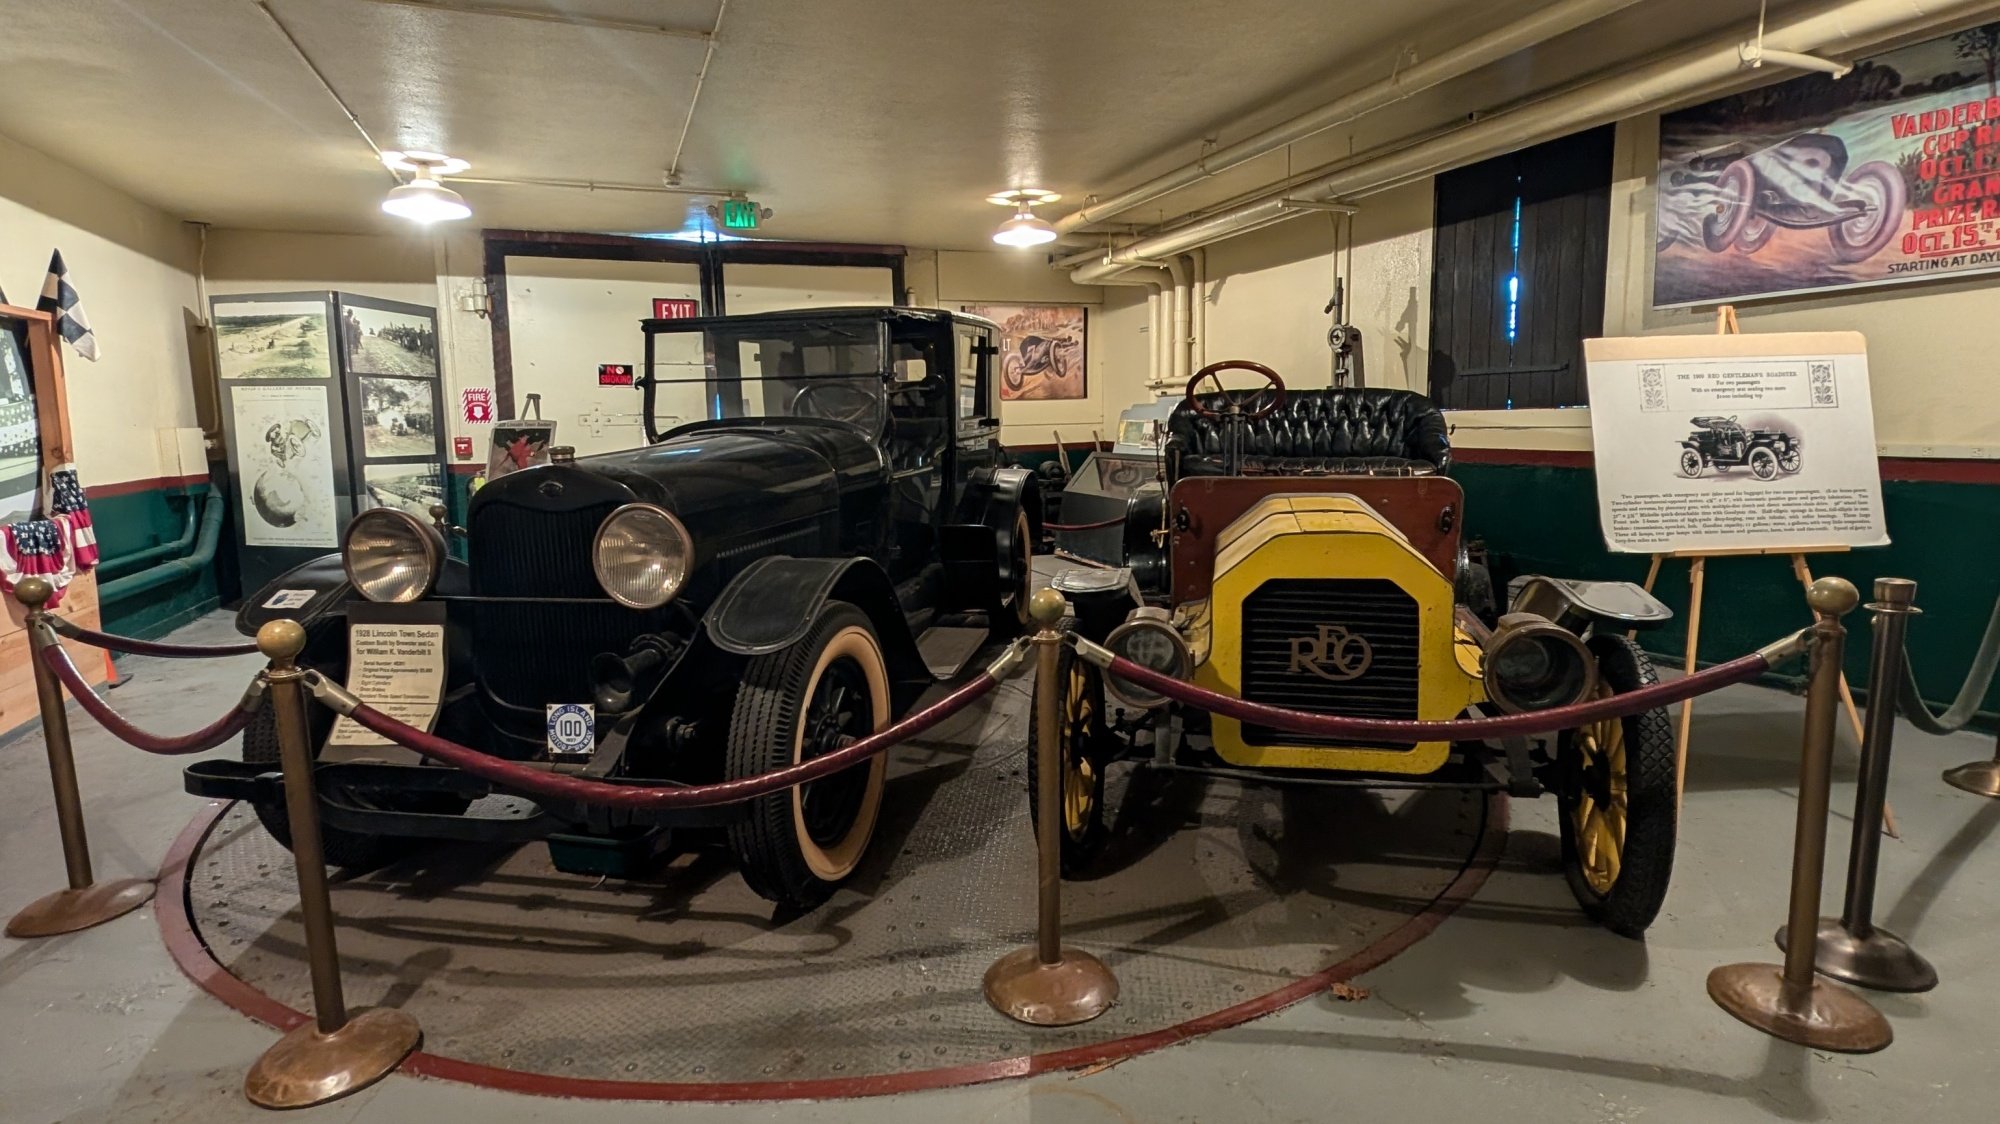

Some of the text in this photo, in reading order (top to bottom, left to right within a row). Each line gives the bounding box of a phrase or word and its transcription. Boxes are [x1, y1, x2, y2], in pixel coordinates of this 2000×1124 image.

[1923, 129, 1970, 157] CUP
[725, 202, 755, 227] EXIT
[1912, 202, 1977, 231] PRIZE
[1902, 231, 1950, 255] OCT.
[1888, 257, 1948, 274] STARTING
[1951, 255, 1967, 267] AT
[662, 303, 691, 319] EXIT
[600, 374, 631, 384] SMOKING
[468, 393, 486, 401] FIRE
[417, 630, 439, 638] Sedan
[1286, 624, 1372, 681] REO
[551, 706, 593, 726] LONG ISLAND
[560, 720, 582, 737] 100
[549, 729, 566, 750] MOTOR
